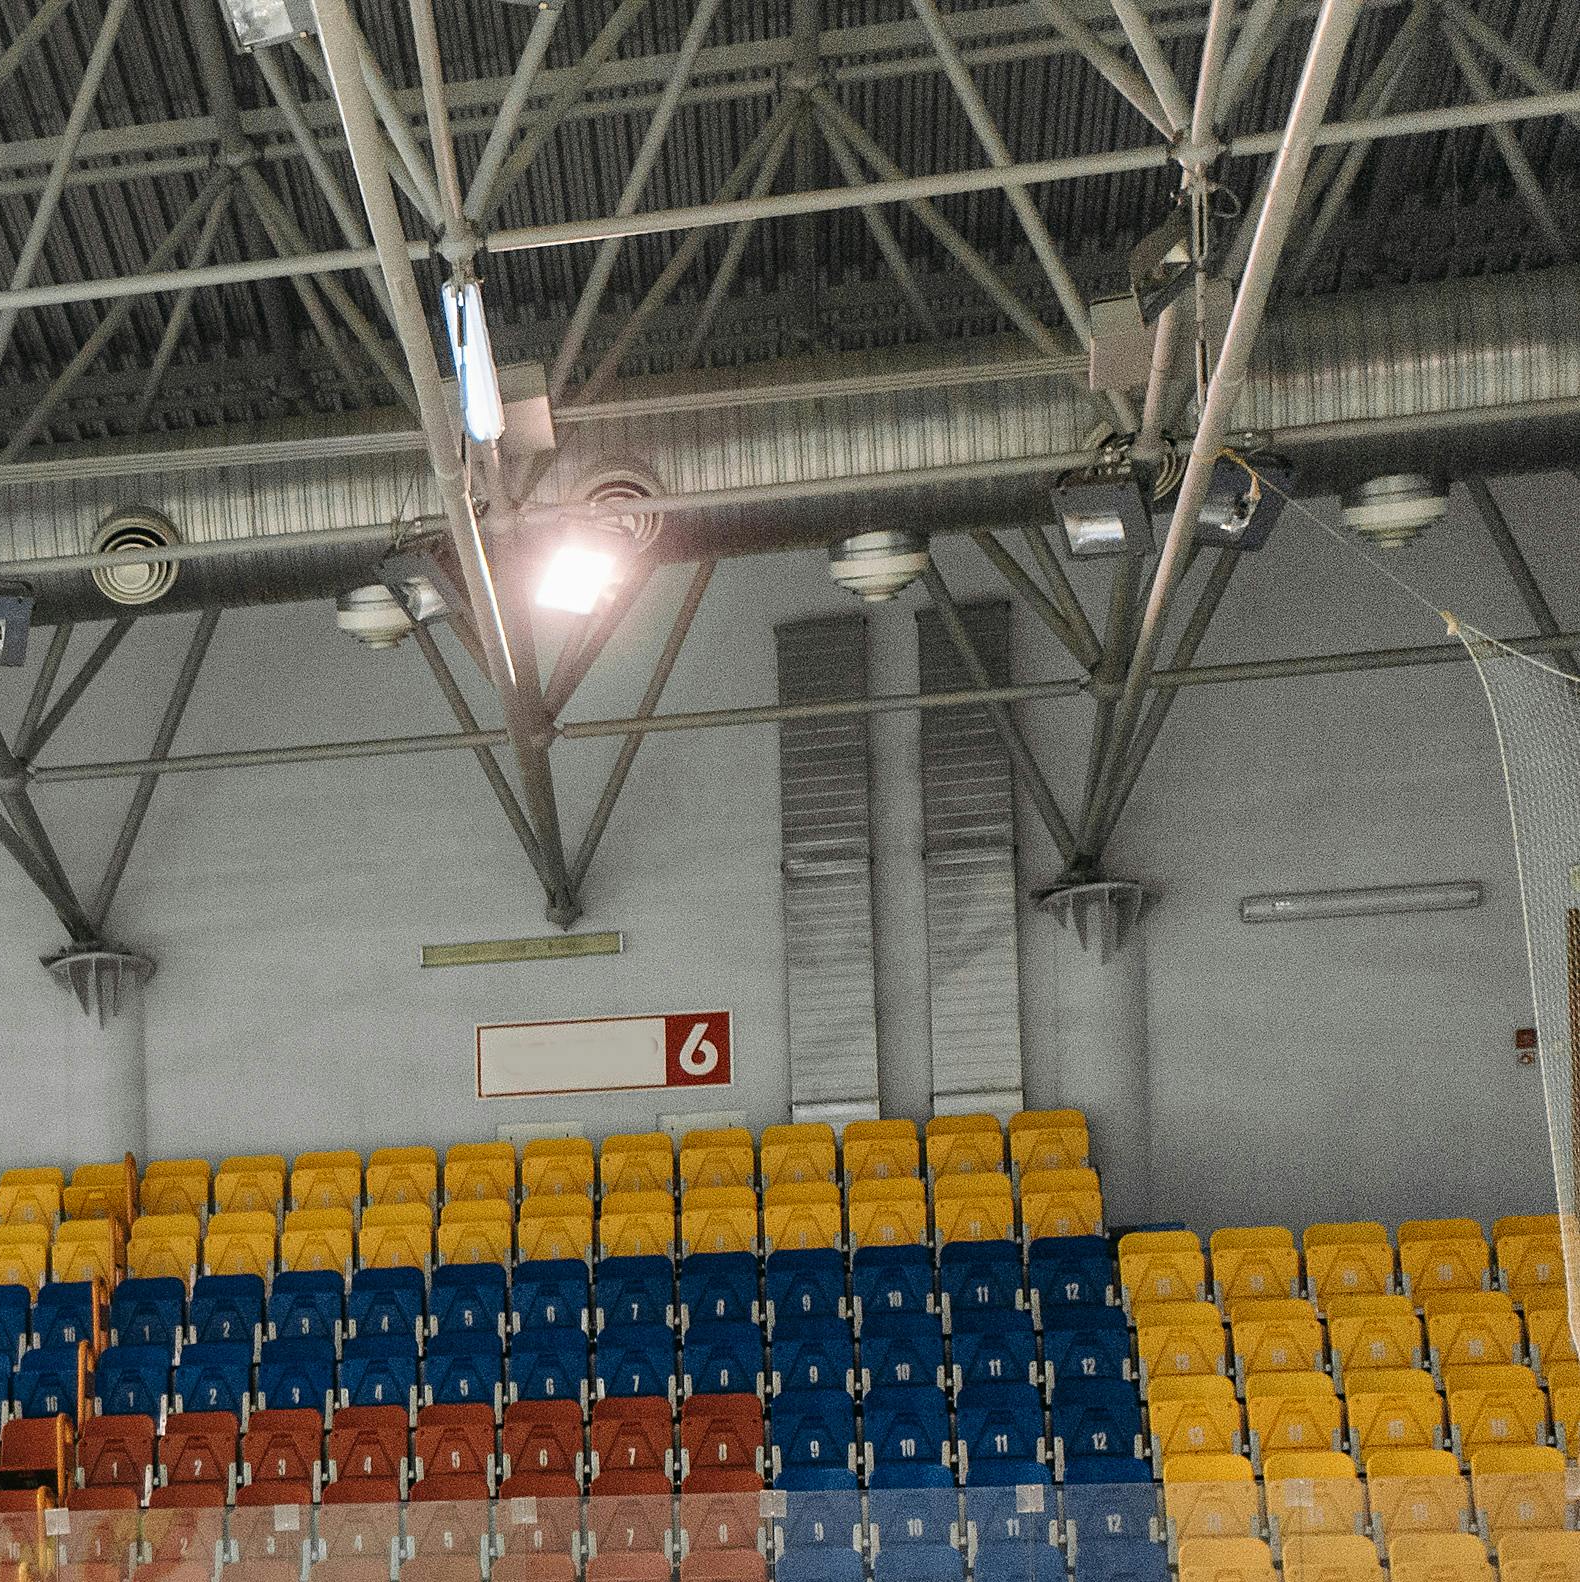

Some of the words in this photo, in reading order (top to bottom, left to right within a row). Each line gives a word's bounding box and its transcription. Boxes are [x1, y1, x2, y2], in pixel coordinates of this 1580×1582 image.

[679, 1022, 719, 1076] 6
[888, 1291, 902, 1306] 10
[977, 1286, 988, 1302] 11
[1065, 1283, 1079, 1299] 12
[716, 1299, 725, 1315] 8
[802, 1294, 811, 1311] 9
[464, 1310, 473, 1325] 5
[546, 1306, 555, 1321] 6
[632, 1303, 638, 1319] 7
[223, 1321, 230, 1337] 2
[301, 1318, 309, 1333] 3
[382, 1316, 388, 1331] 4
[63, 1326, 76, 1344] 16
[144, 1326, 149, 1340] 1
[809, 1366, 818, 1382] 9
[896, 1364, 910, 1380] 10
[989, 1359, 1001, 1375] 11
[1082, 1358, 1095, 1375] 12
[633, 1375, 639, 1391] 7
[720, 1369, 728, 1386] 8
[375, 1385, 382, 1400] 4
[460, 1379, 468, 1395] 5
[546, 1378, 554, 1395] 6
[46, 1396, 57, 1411] 16
[128, 1392, 134, 1406] 1
[209, 1388, 217, 1404] 2
[292, 1388, 300, 1403] 3
[810, 1441, 819, 1457] 9
[900, 1439, 915, 1456] 10
[995, 1435, 1008, 1452] 11
[1092, 1432, 1107, 1450] 12
[451, 1451, 460, 1468] 5
[539, 1449, 548, 1466] 6
[628, 1448, 636, 1464] 7
[718, 1444, 727, 1460] 8
[194, 1459, 202, 1475] 2
[278, 1459, 286, 1475] 3
[364, 1457, 371, 1473] 4
[907, 1519, 923, 1536] 10
[1006, 1519, 1019, 1536] 11
[1107, 1514, 1121, 1532] 12
[814, 1523, 823, 1540] 9
